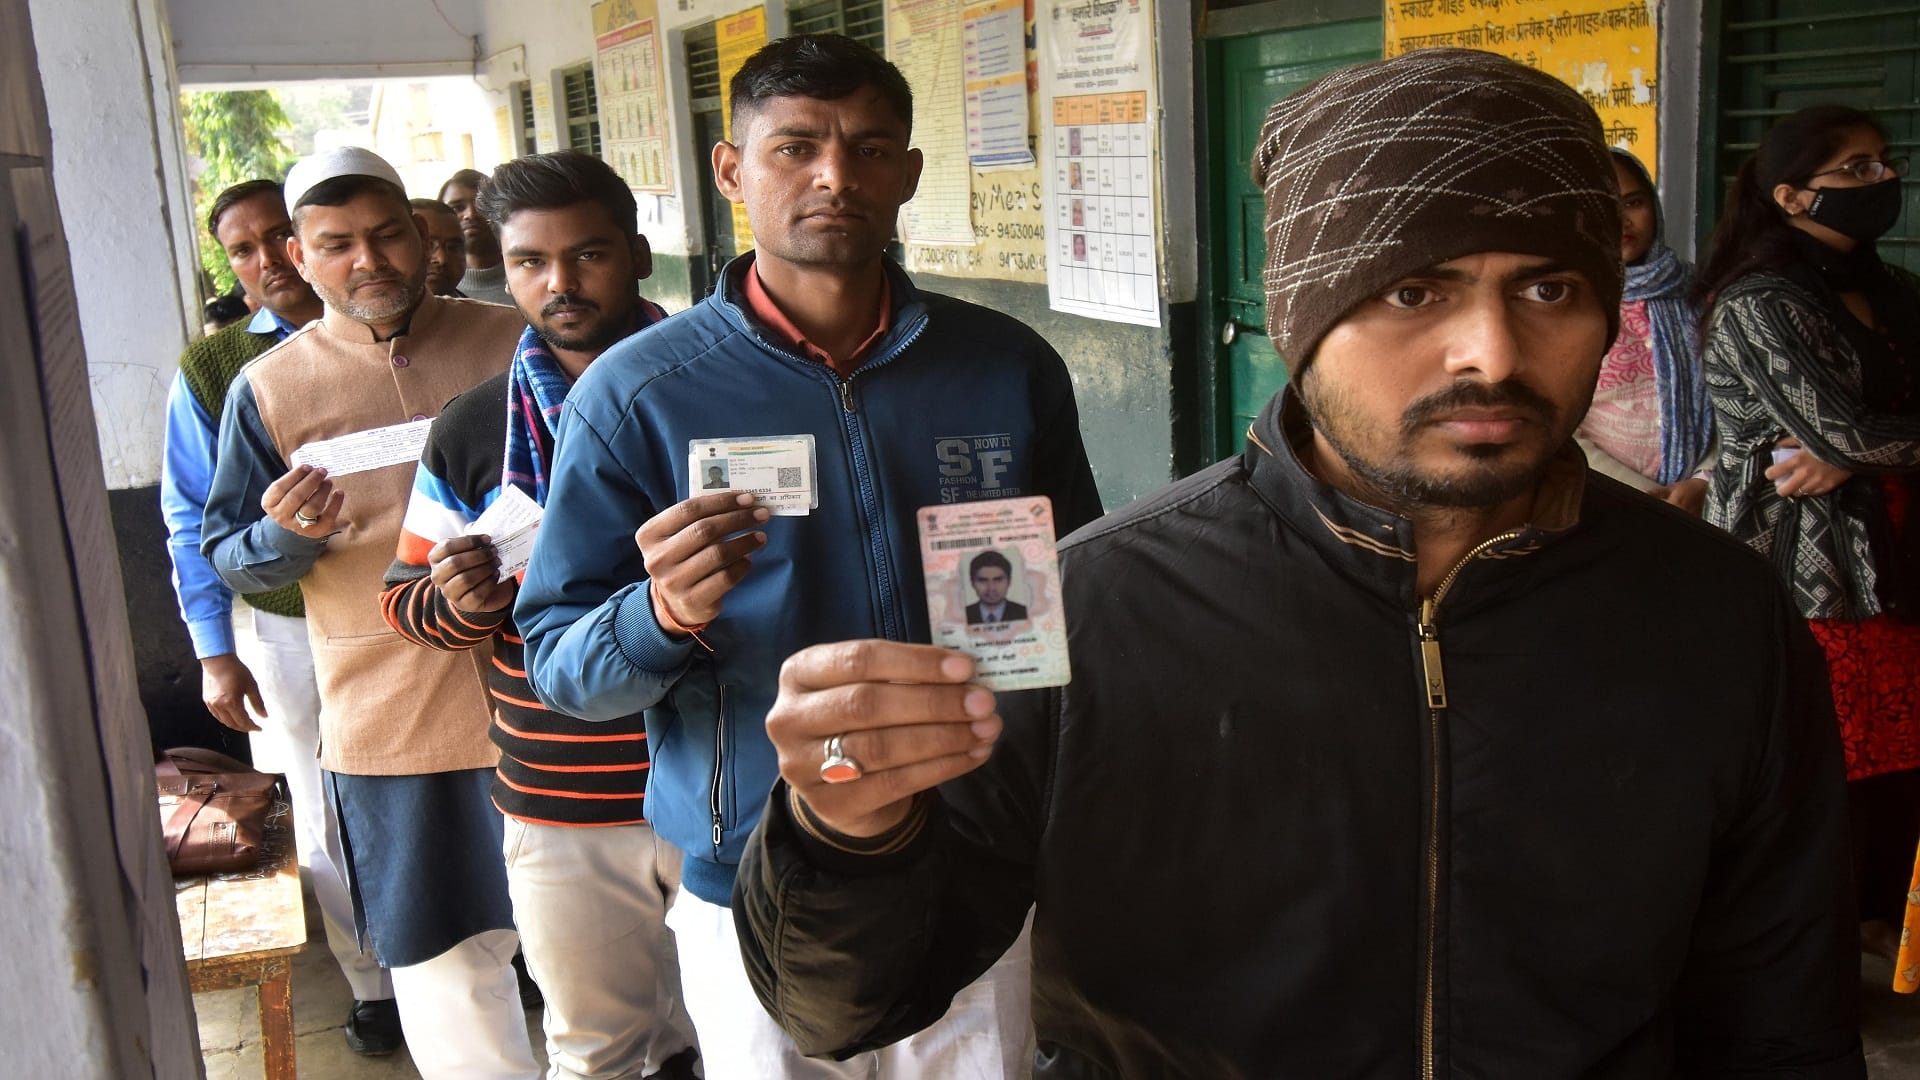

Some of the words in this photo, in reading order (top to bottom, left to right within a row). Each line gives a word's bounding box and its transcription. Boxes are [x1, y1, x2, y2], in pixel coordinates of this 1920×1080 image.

[973, 222, 989, 238] asic
[974, 438, 999, 449] NOW
[1001, 437, 1011, 447] IT
[939, 476, 977, 485] FASHION
[940, 487, 960, 503] SF
